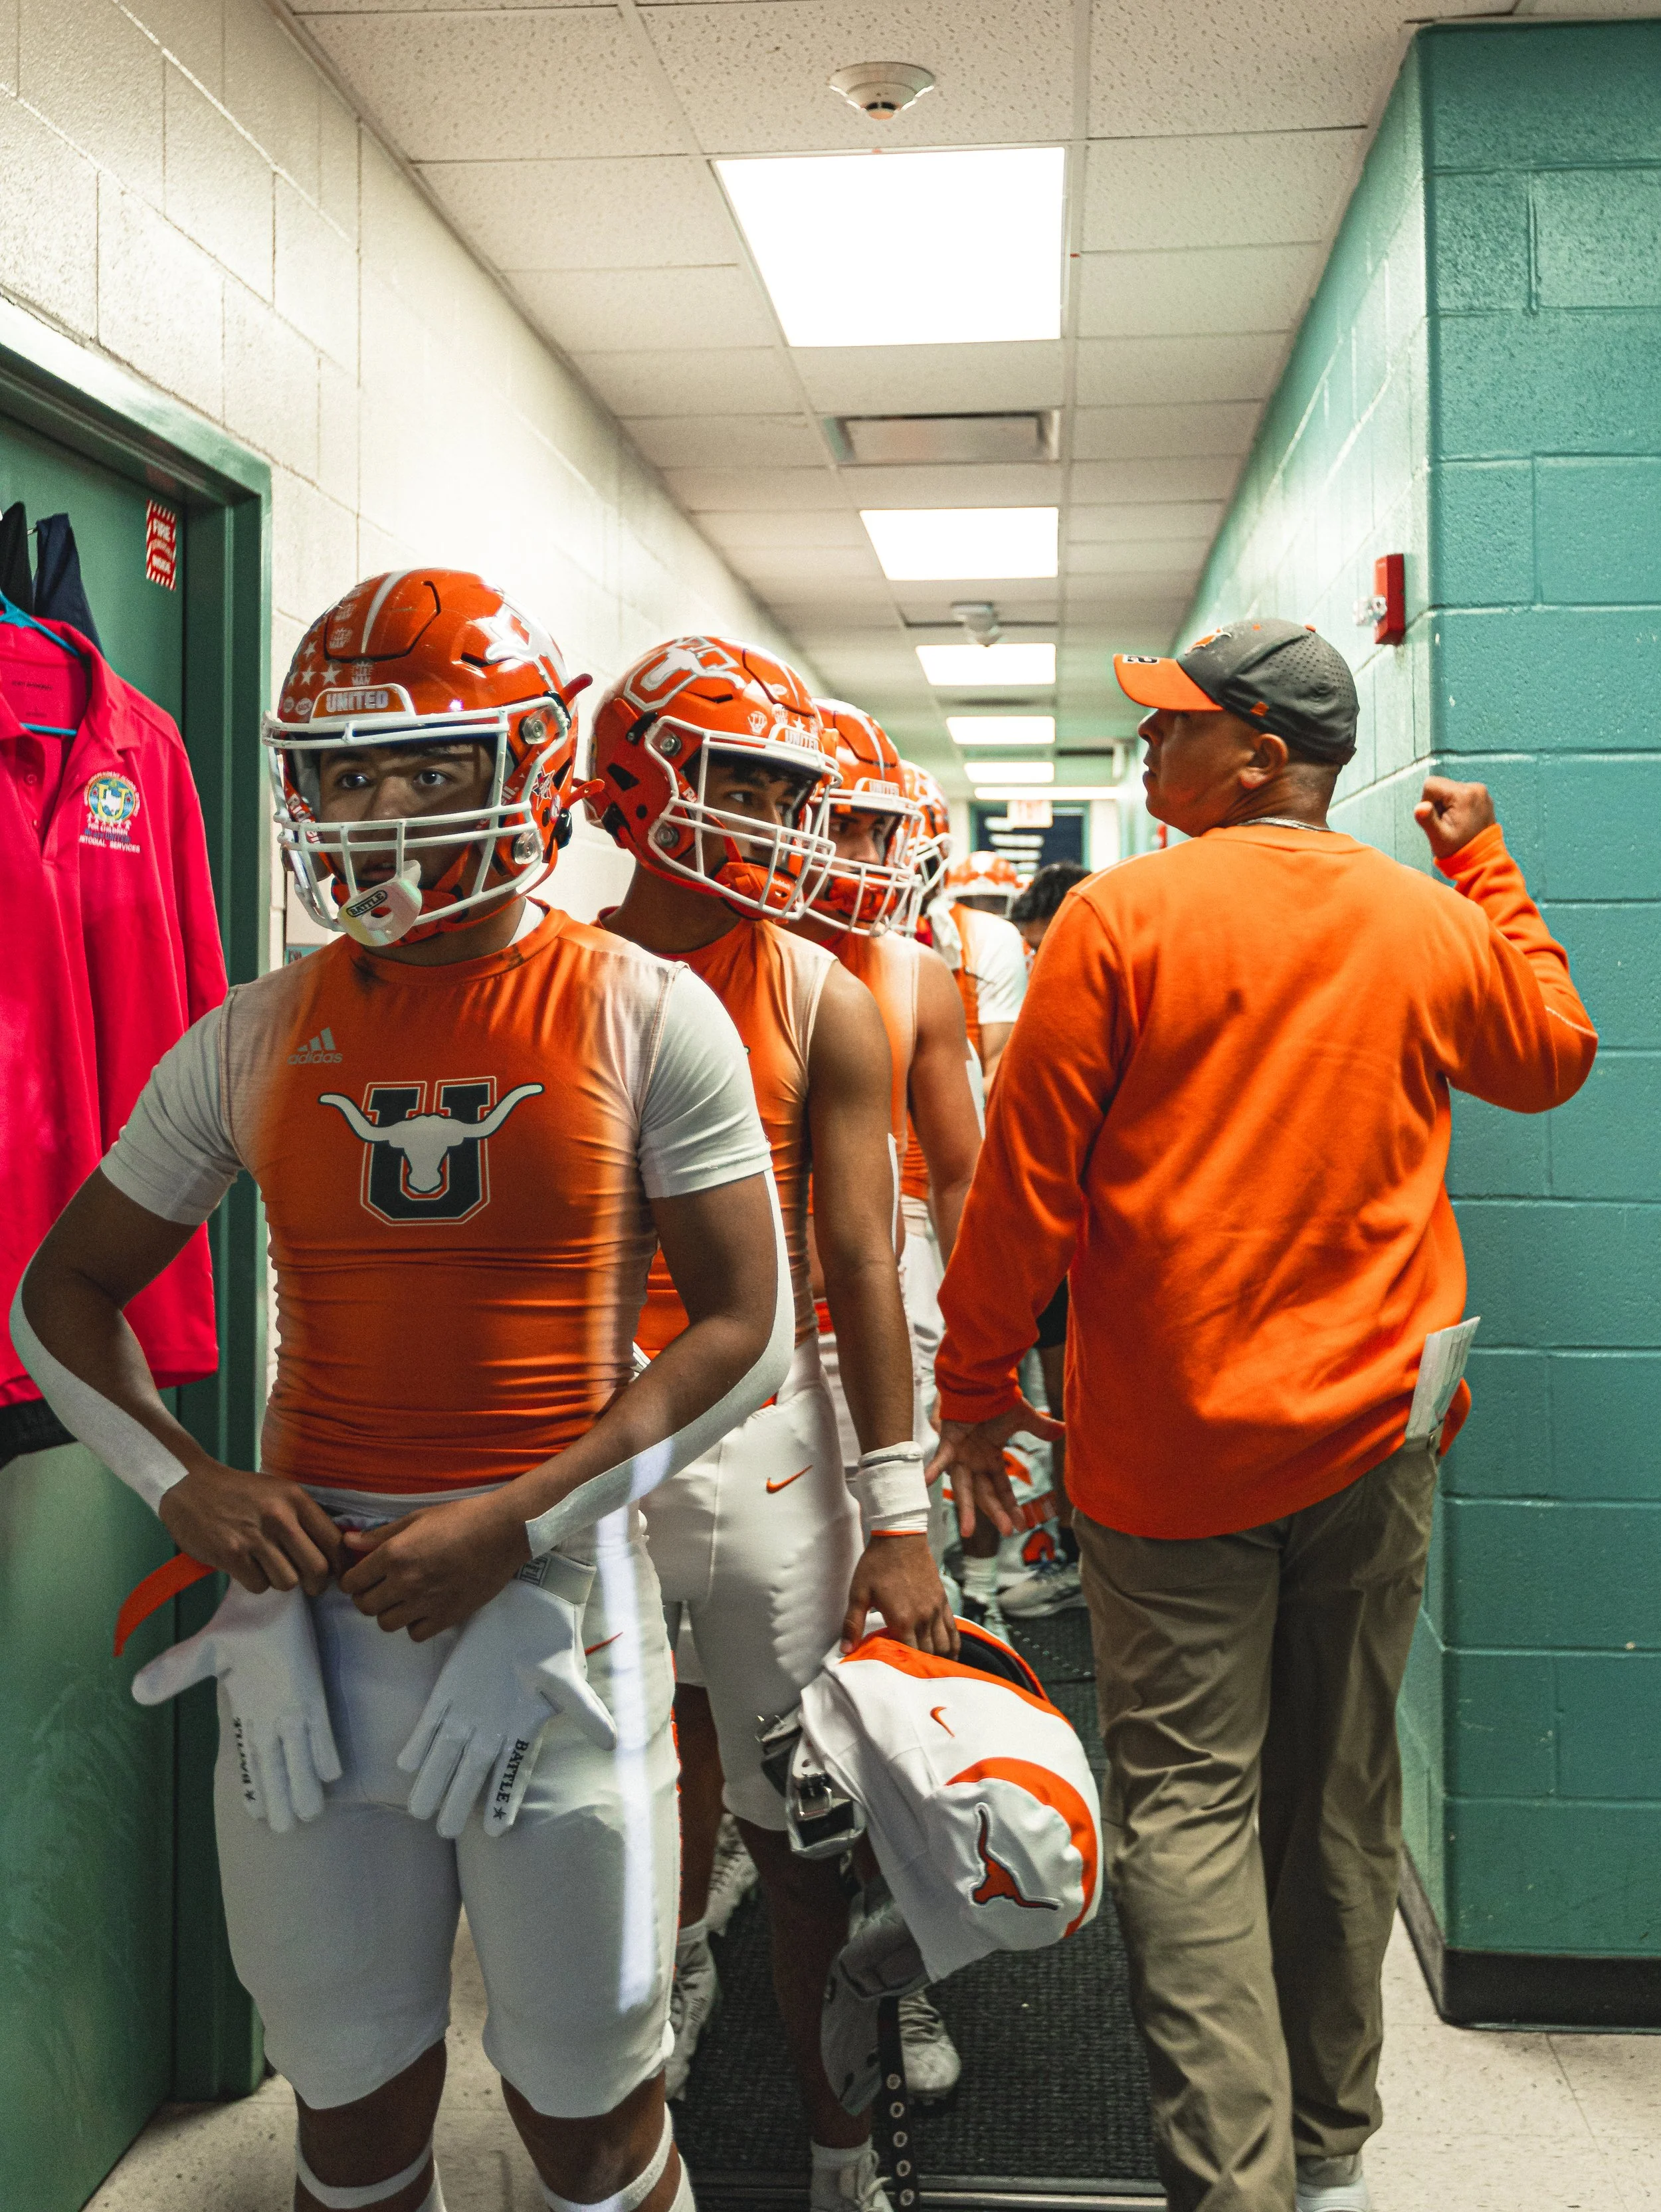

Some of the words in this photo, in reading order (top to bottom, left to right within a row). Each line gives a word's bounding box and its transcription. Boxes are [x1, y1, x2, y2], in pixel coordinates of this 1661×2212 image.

[326, 690, 389, 712] UNITED
[350, 892, 385, 916] BATTLE
[287, 1051, 343, 1064] adidas
[496, 1738, 530, 1803] BATTLE
